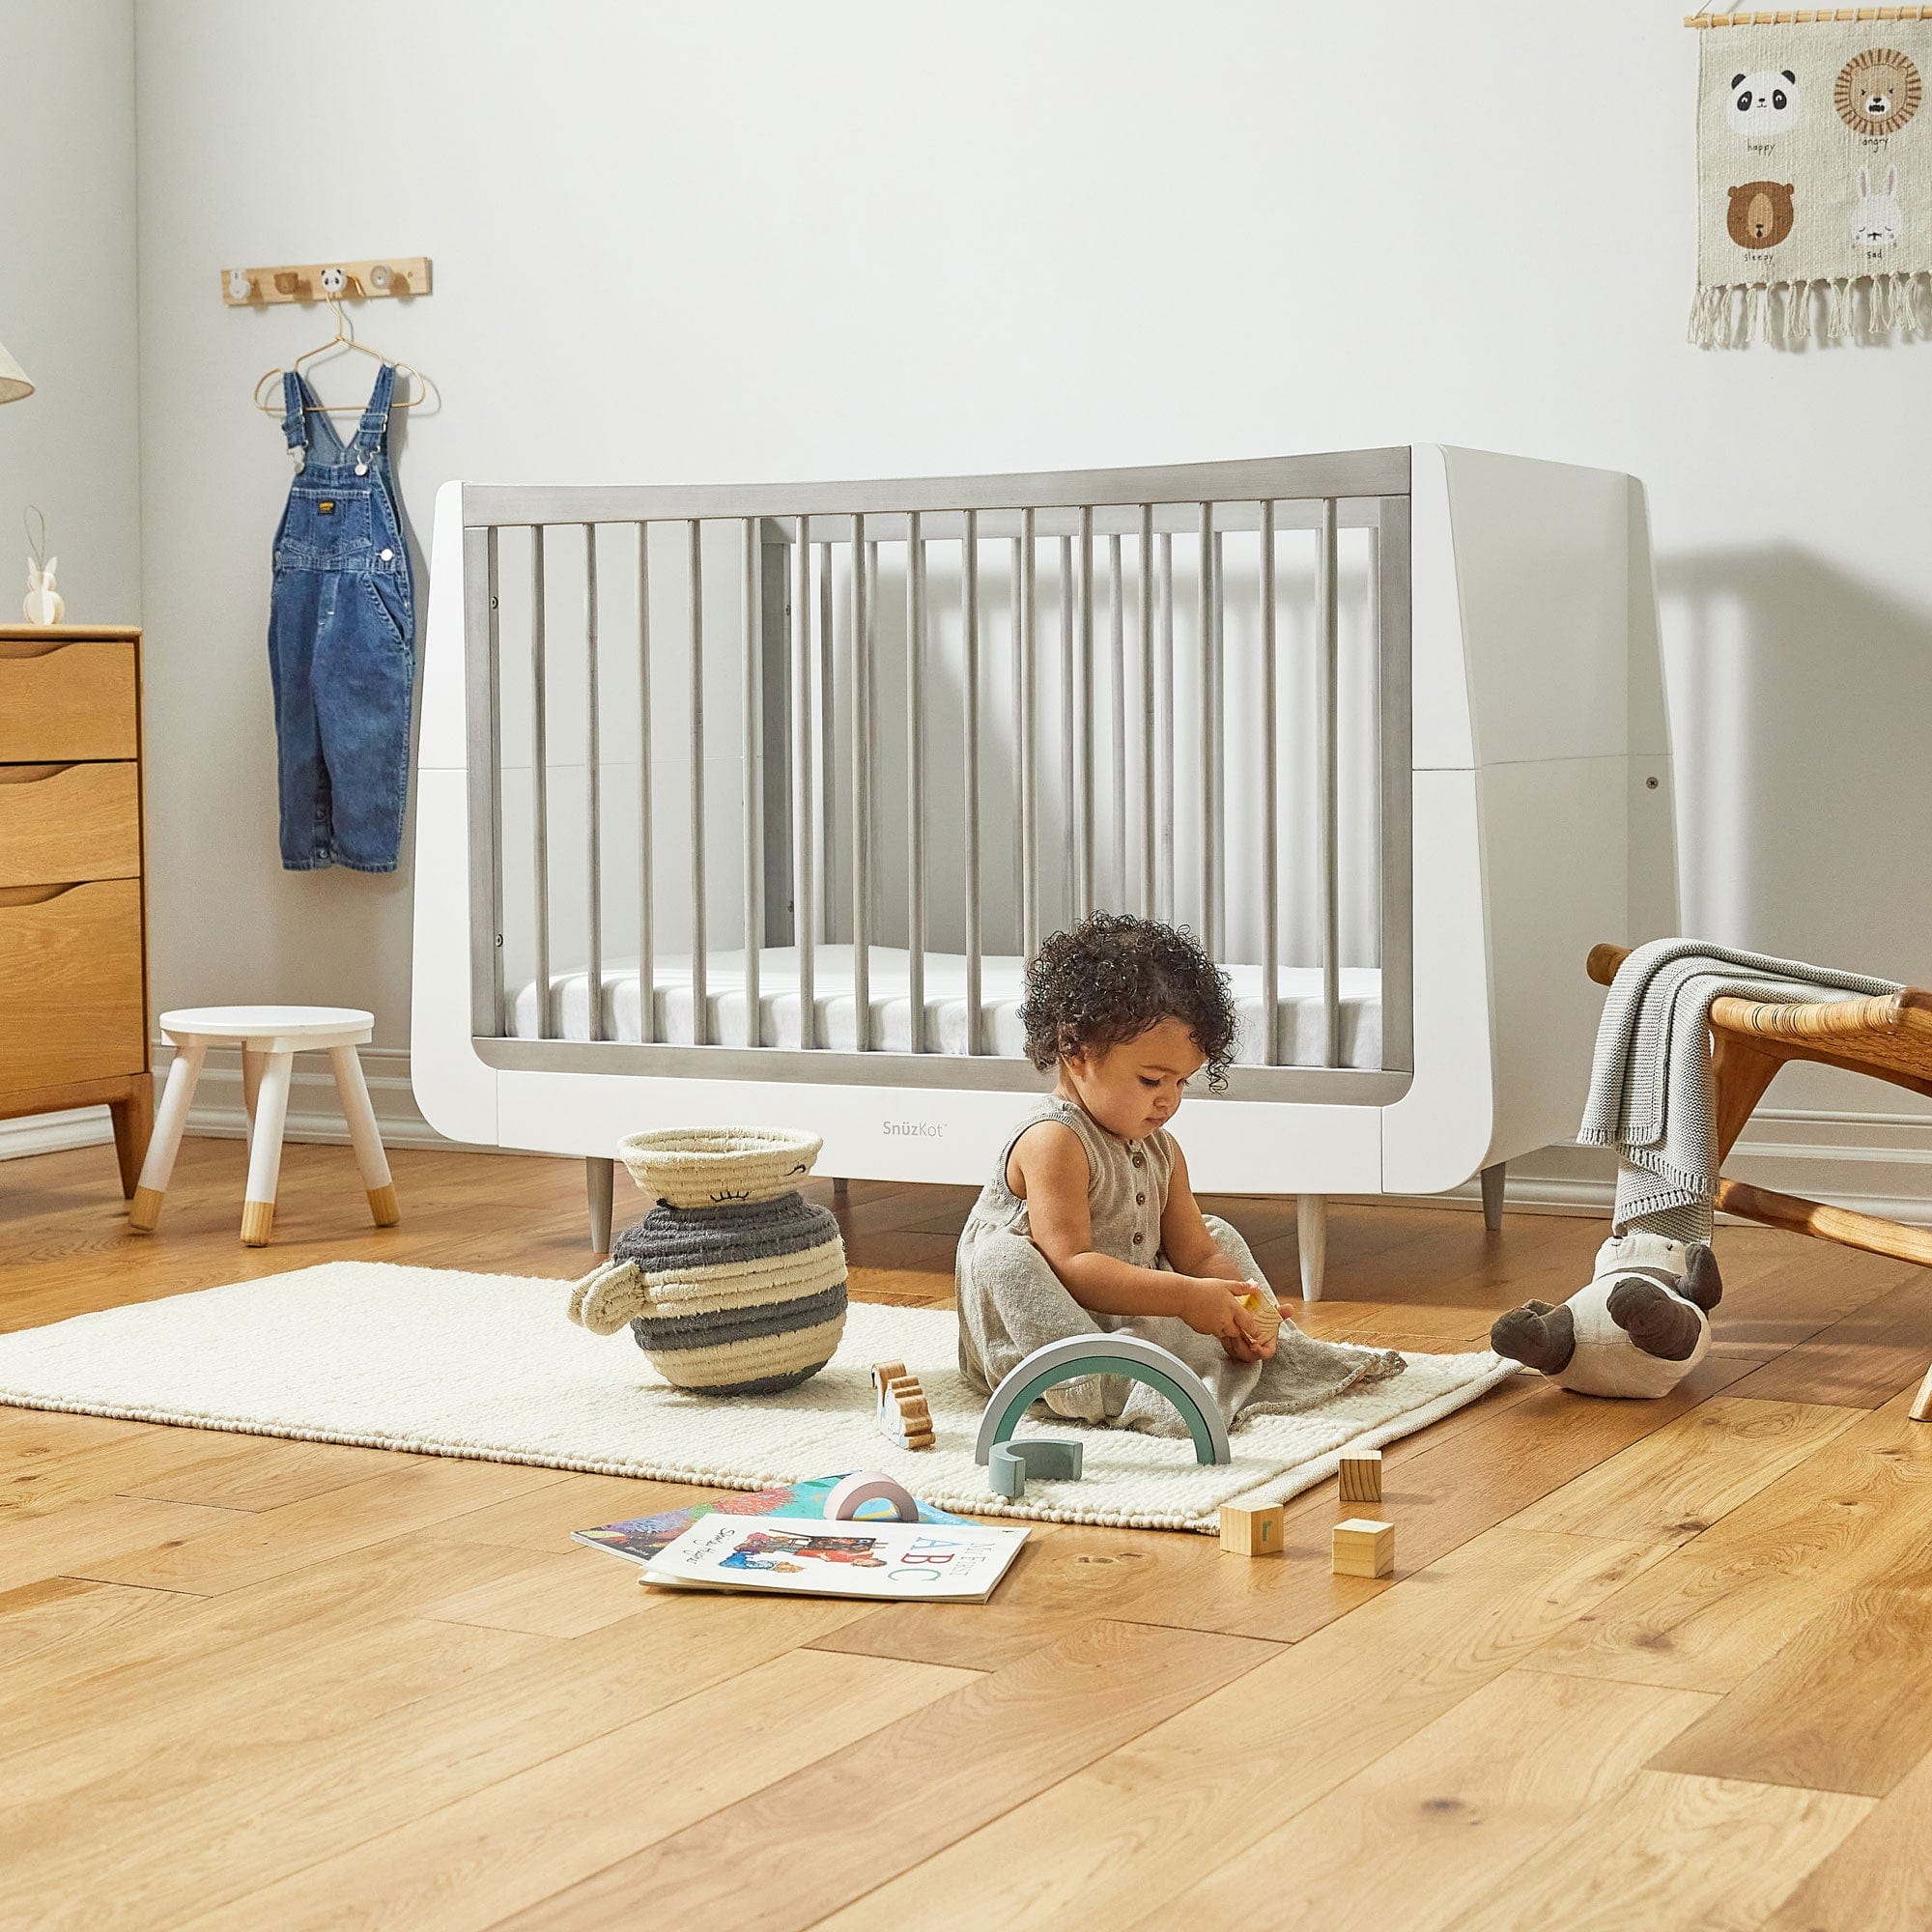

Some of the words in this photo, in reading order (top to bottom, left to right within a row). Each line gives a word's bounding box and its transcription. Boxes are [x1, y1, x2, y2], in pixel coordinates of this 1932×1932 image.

[1747, 137, 1776, 157] happy
[1861, 137, 1889, 154] angry
[1744, 251, 1774, 266] sleepy
[1866, 248, 1884, 260] sad
[1262, 1520, 1272, 1543] r
